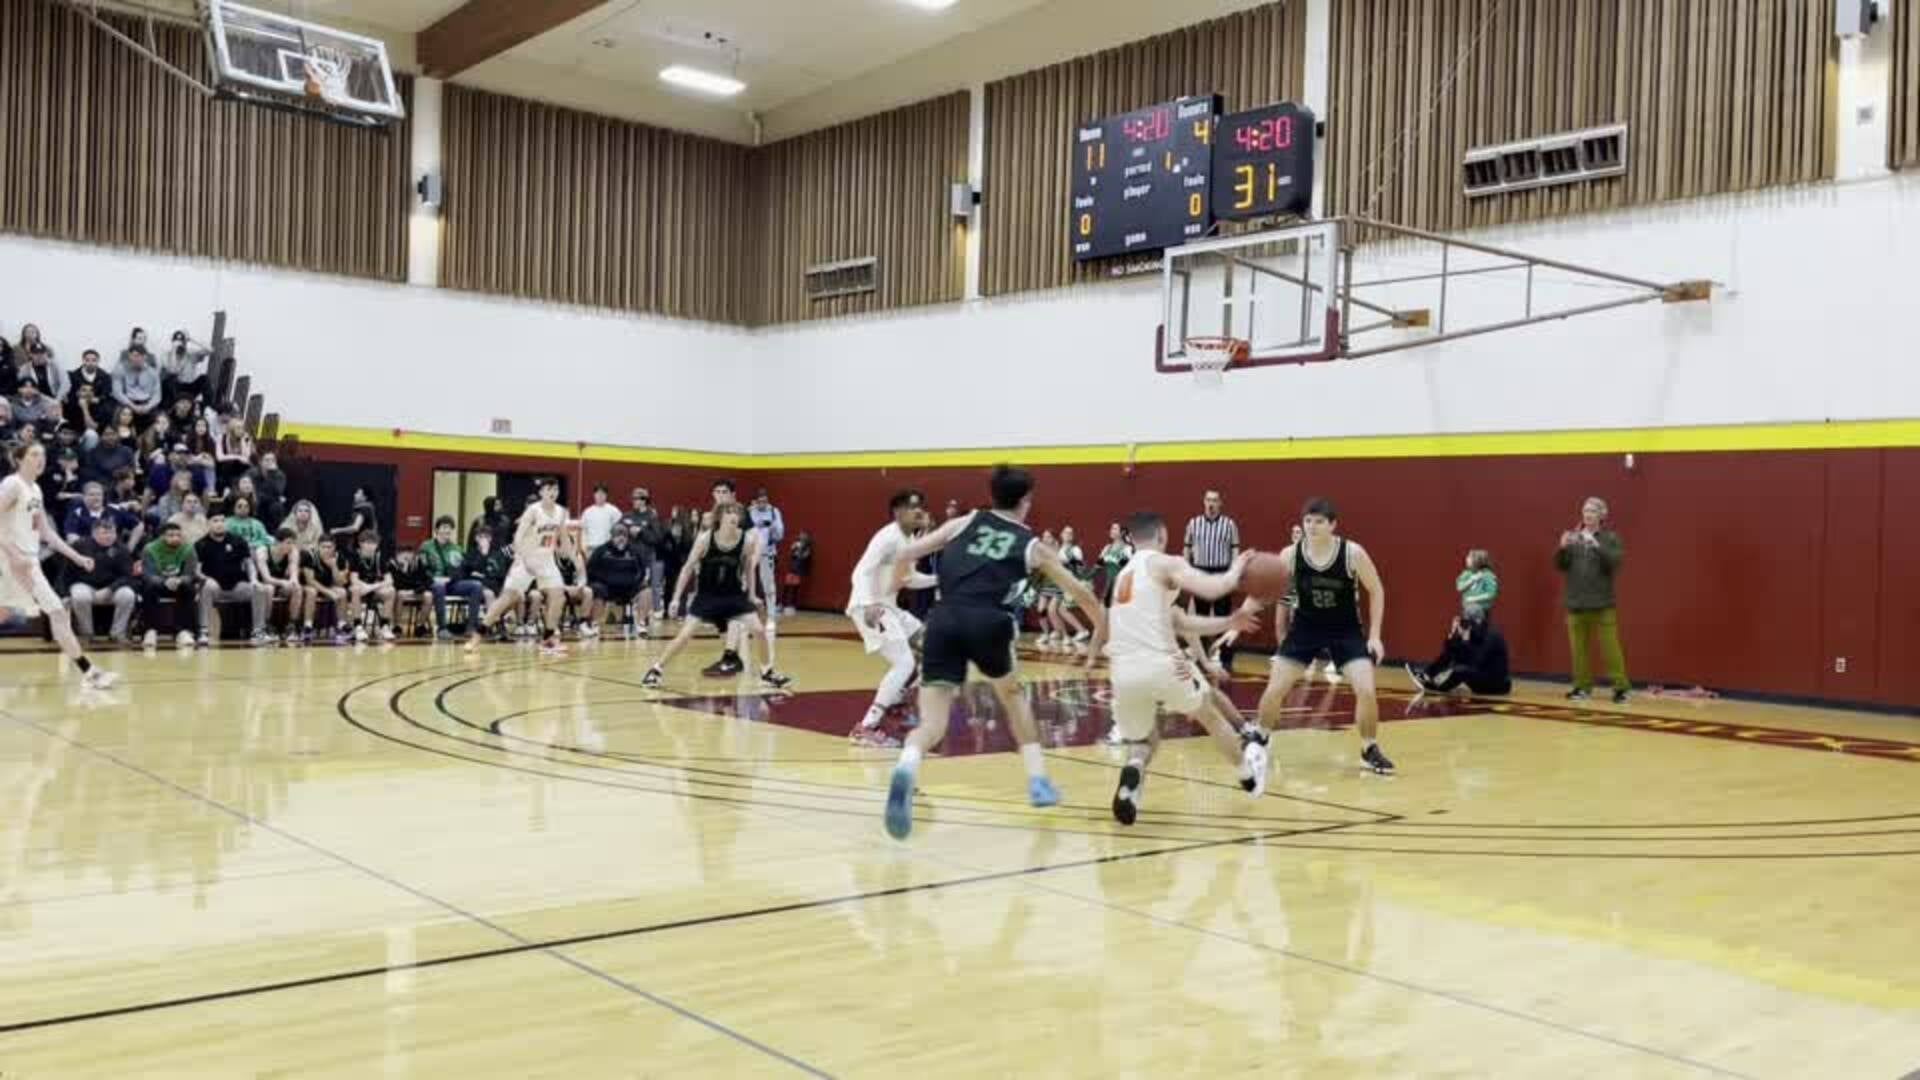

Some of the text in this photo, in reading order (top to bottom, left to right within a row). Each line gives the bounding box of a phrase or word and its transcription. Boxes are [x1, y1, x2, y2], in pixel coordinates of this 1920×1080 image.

[1079, 127, 1102, 142] Home
[1123, 108, 1169, 141] 4:20
[1193, 119, 1209, 144] 4
[1235, 116, 1292, 152] 4:20
[1087, 143, 1105, 171] 11
[1234, 162, 1277, 209] 31
[1189, 193, 1201, 216] 0
[1080, 213, 1091, 235] 0
[967, 526, 1014, 559] 33
[1311, 590, 1337, 608] 22
